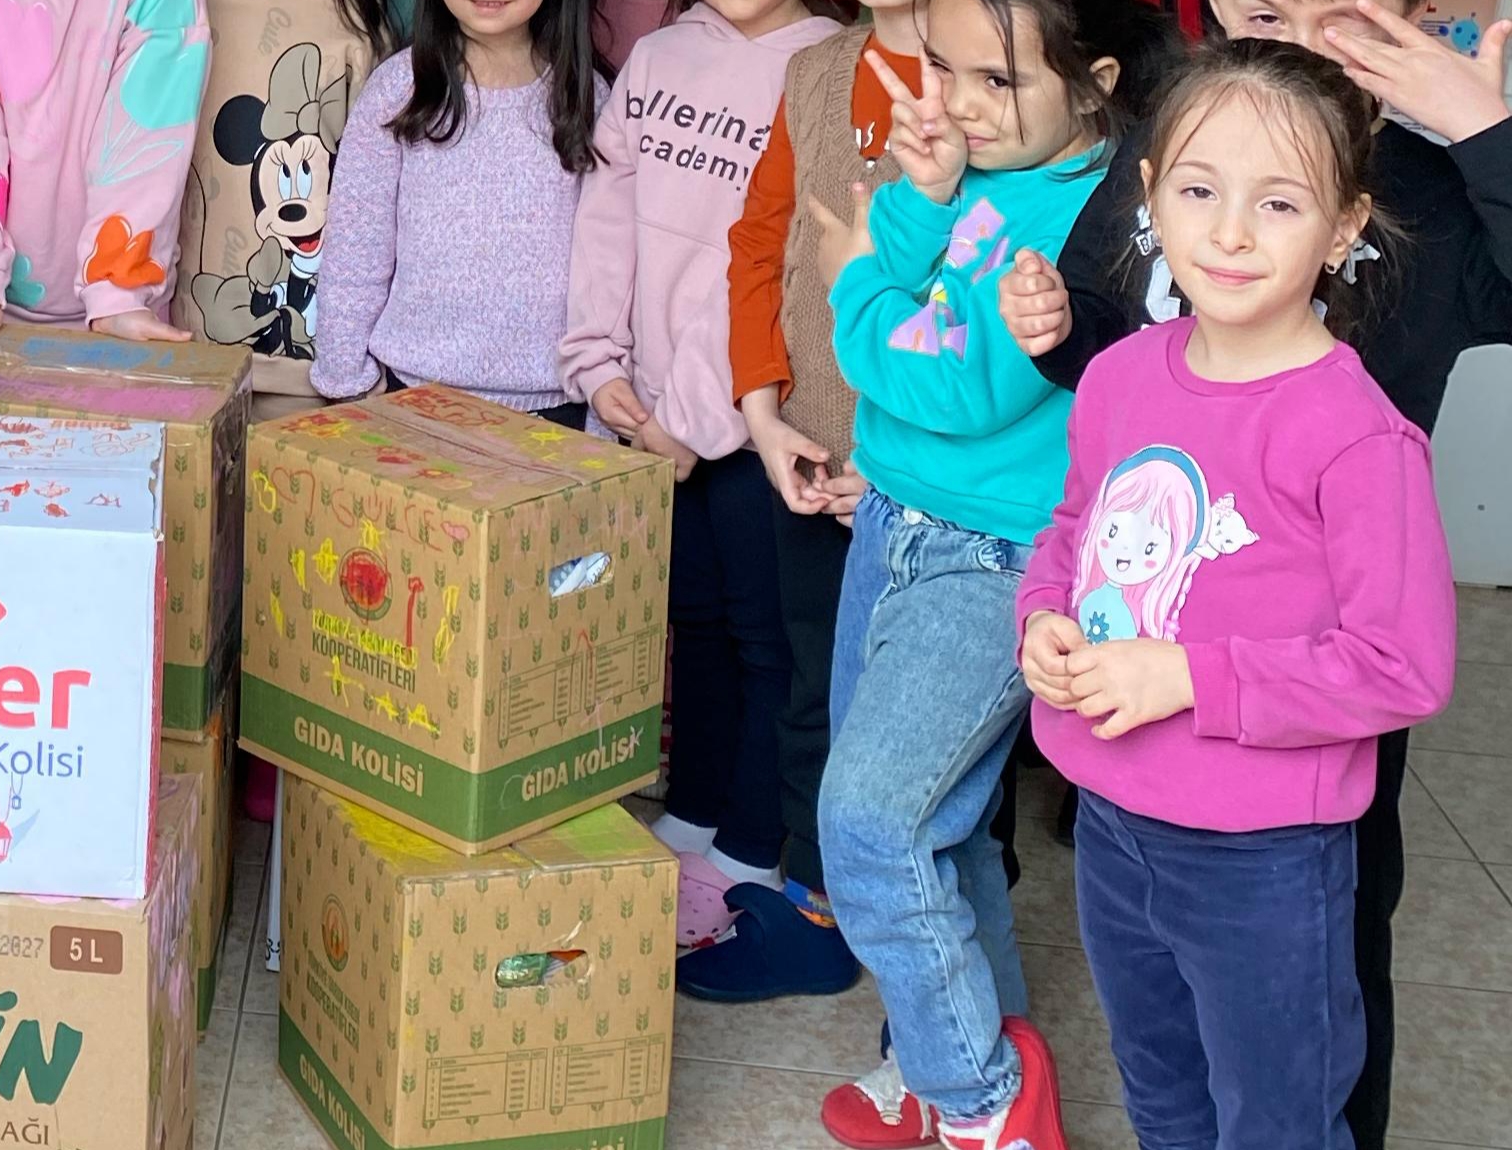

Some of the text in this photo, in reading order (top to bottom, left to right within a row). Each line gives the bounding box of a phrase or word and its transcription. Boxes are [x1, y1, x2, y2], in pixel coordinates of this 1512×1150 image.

[294, 716, 424, 797] GIDA KOLİSİ
[521, 761, 568, 802] GIDA
[69, 937, 104, 962] 5 L
[299, 1053, 327, 1108] GIDA
